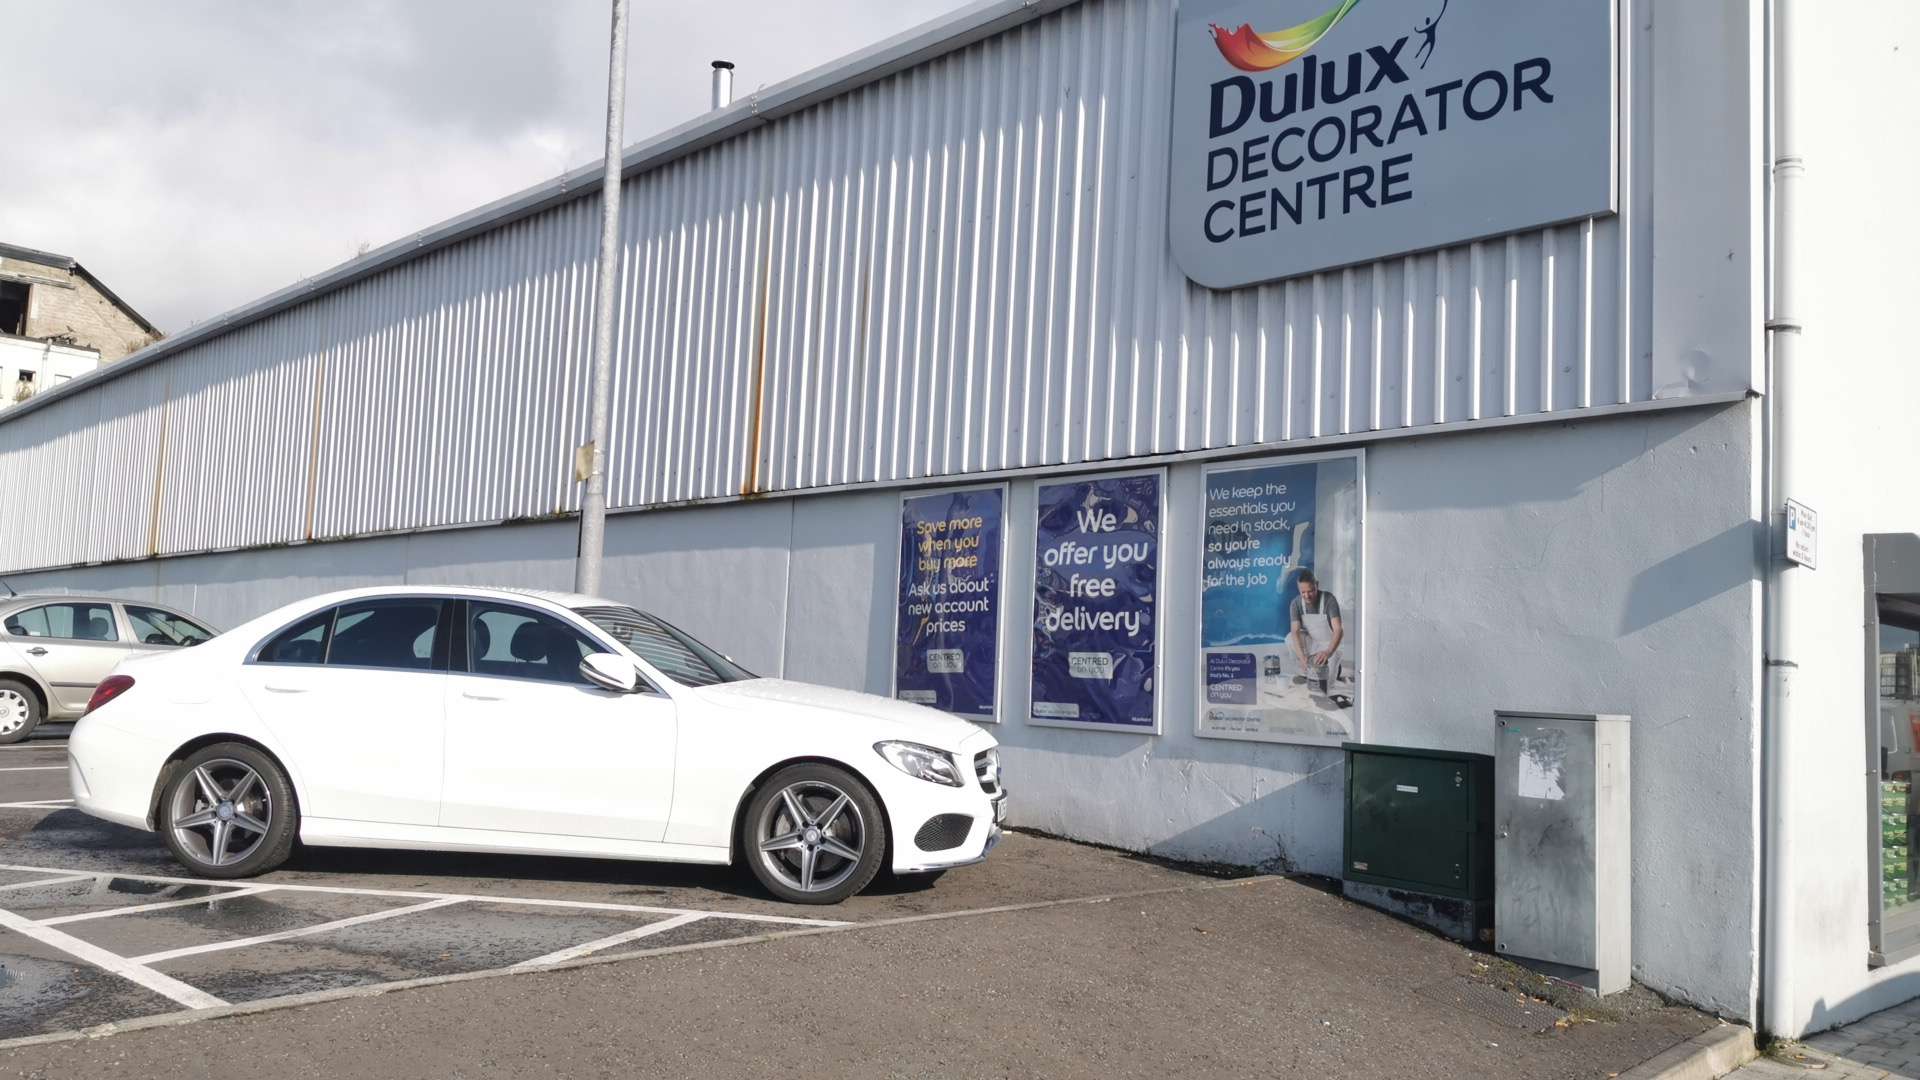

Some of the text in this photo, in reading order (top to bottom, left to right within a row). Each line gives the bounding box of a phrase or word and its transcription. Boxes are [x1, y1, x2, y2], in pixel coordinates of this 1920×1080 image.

[1208, 36, 1410, 139] Dulux
[1206, 56, 1554, 192] DECORATOR
[1203, 153, 1413, 244] CENTRE
[1209, 482, 1287, 500] We keep the
[1208, 500, 1296, 518] essentials you
[916, 515, 983, 535] Save more
[1077, 508, 1117, 534] We
[1208, 517, 1291, 535] need in stock,
[918, 535, 979, 553] when you
[1207, 542, 1222, 553] so
[918, 554, 978, 573] buy more
[1044, 541, 1148, 569] offer you
[1207, 553, 1291, 571] always ready
[908, 577, 990, 597] Ask us about
[1070, 573, 1116, 598] free
[1206, 572, 1268, 589] for the job
[908, 596, 990, 616] new account
[926, 618, 966, 637] prices
[1045, 605, 1141, 637] delivery
[1071, 656, 1109, 666] CENTRED
[1209, 683, 1243, 692] CENTRED
